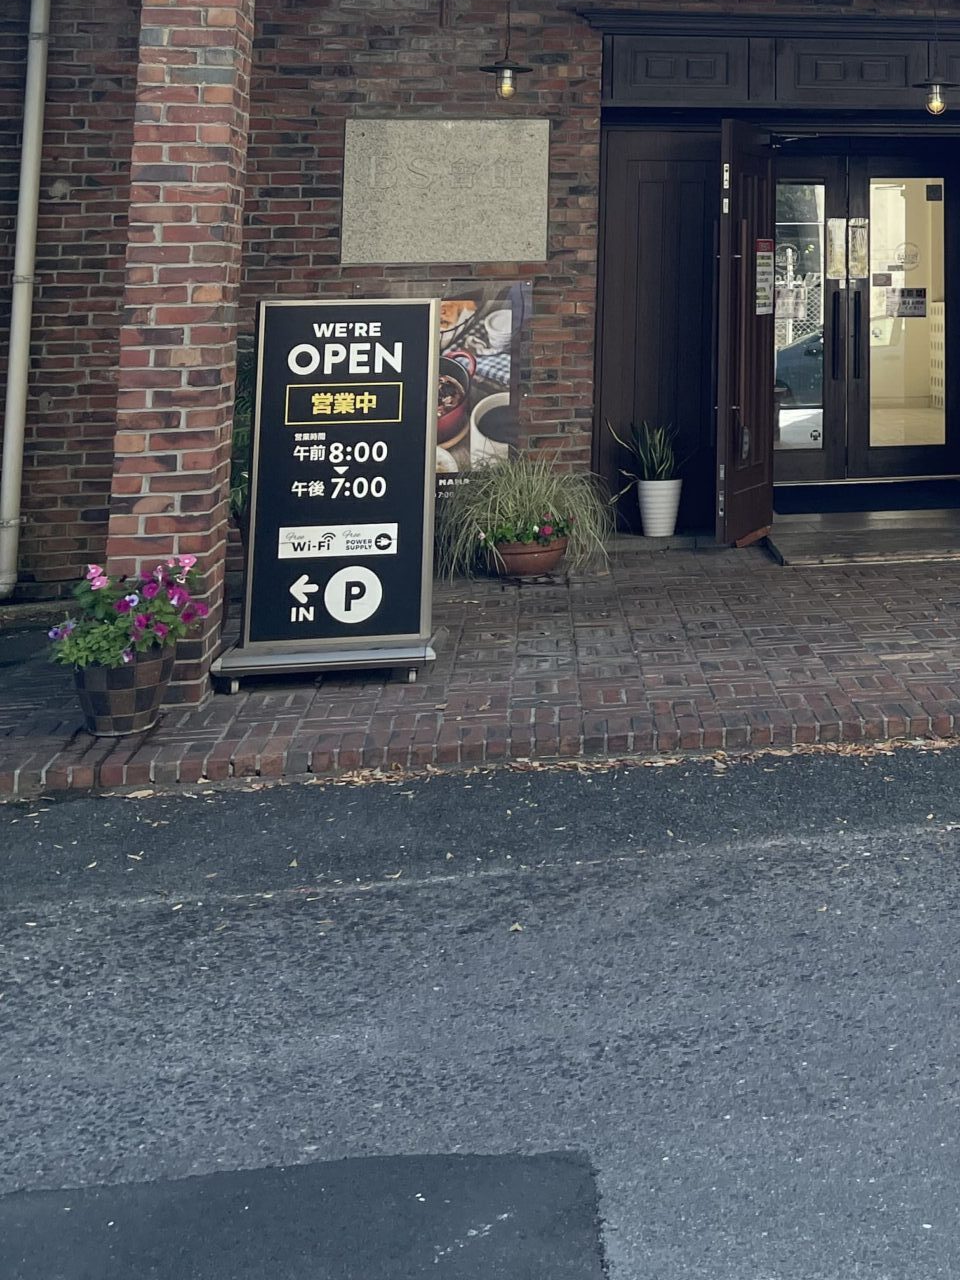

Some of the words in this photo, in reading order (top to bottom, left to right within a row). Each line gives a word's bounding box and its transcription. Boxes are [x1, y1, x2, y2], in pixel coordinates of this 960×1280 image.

[313, 322, 381, 337] WE'RE
[287, 342, 403, 375] OPEN
[311, 391, 377, 415] 営業中
[294, 432, 326, 441] 営業時間
[328, 441, 388, 464] 8:00
[330, 476, 387, 499] 7:00
[342, 529, 361, 538] Free
[292, 540, 331, 552] Wi-Fi
[344, 580, 367, 612] P
[290, 606, 315, 623] IN
